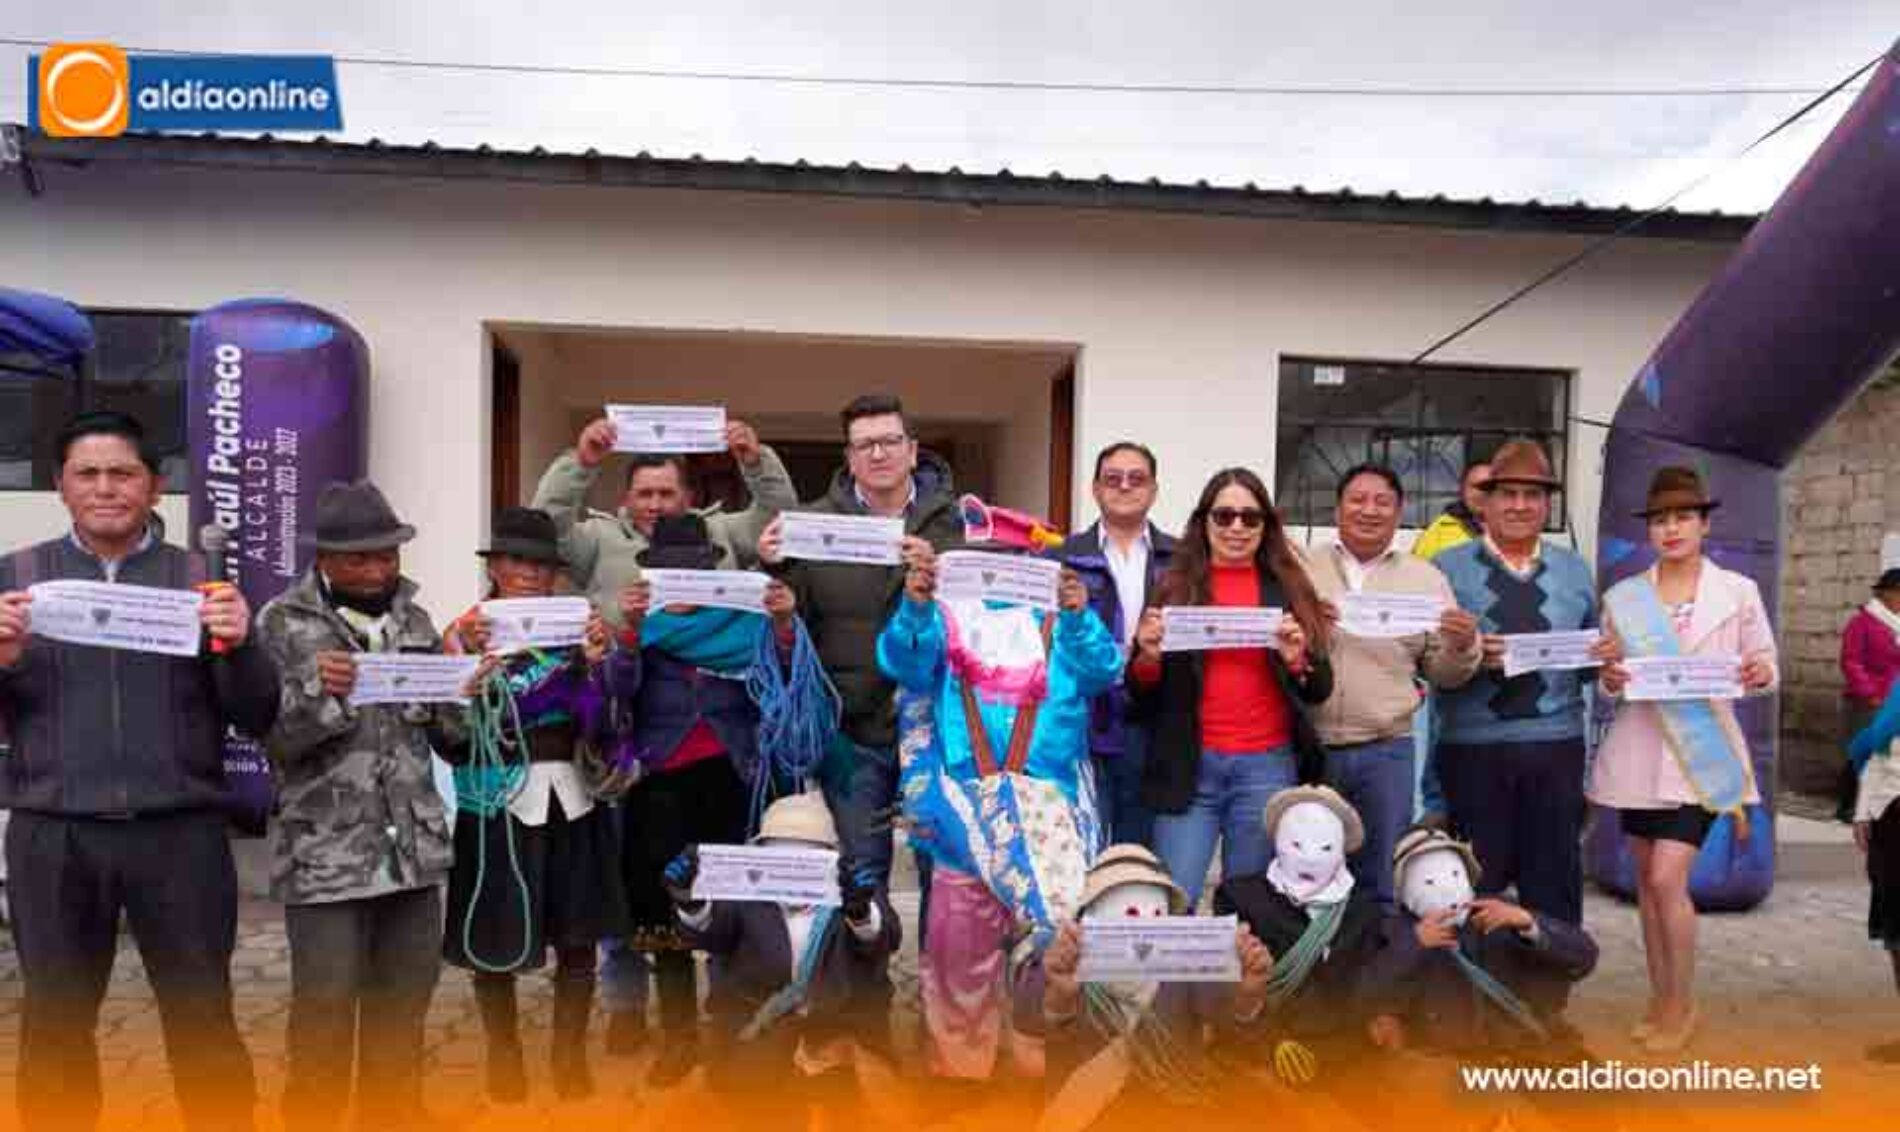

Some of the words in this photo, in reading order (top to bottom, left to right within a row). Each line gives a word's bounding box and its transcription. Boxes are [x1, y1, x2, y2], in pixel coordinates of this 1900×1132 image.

[208, 344, 241, 475] Pacheco
[206, 480, 240, 547] aúl
[246, 438, 268, 562] ALCALDE
